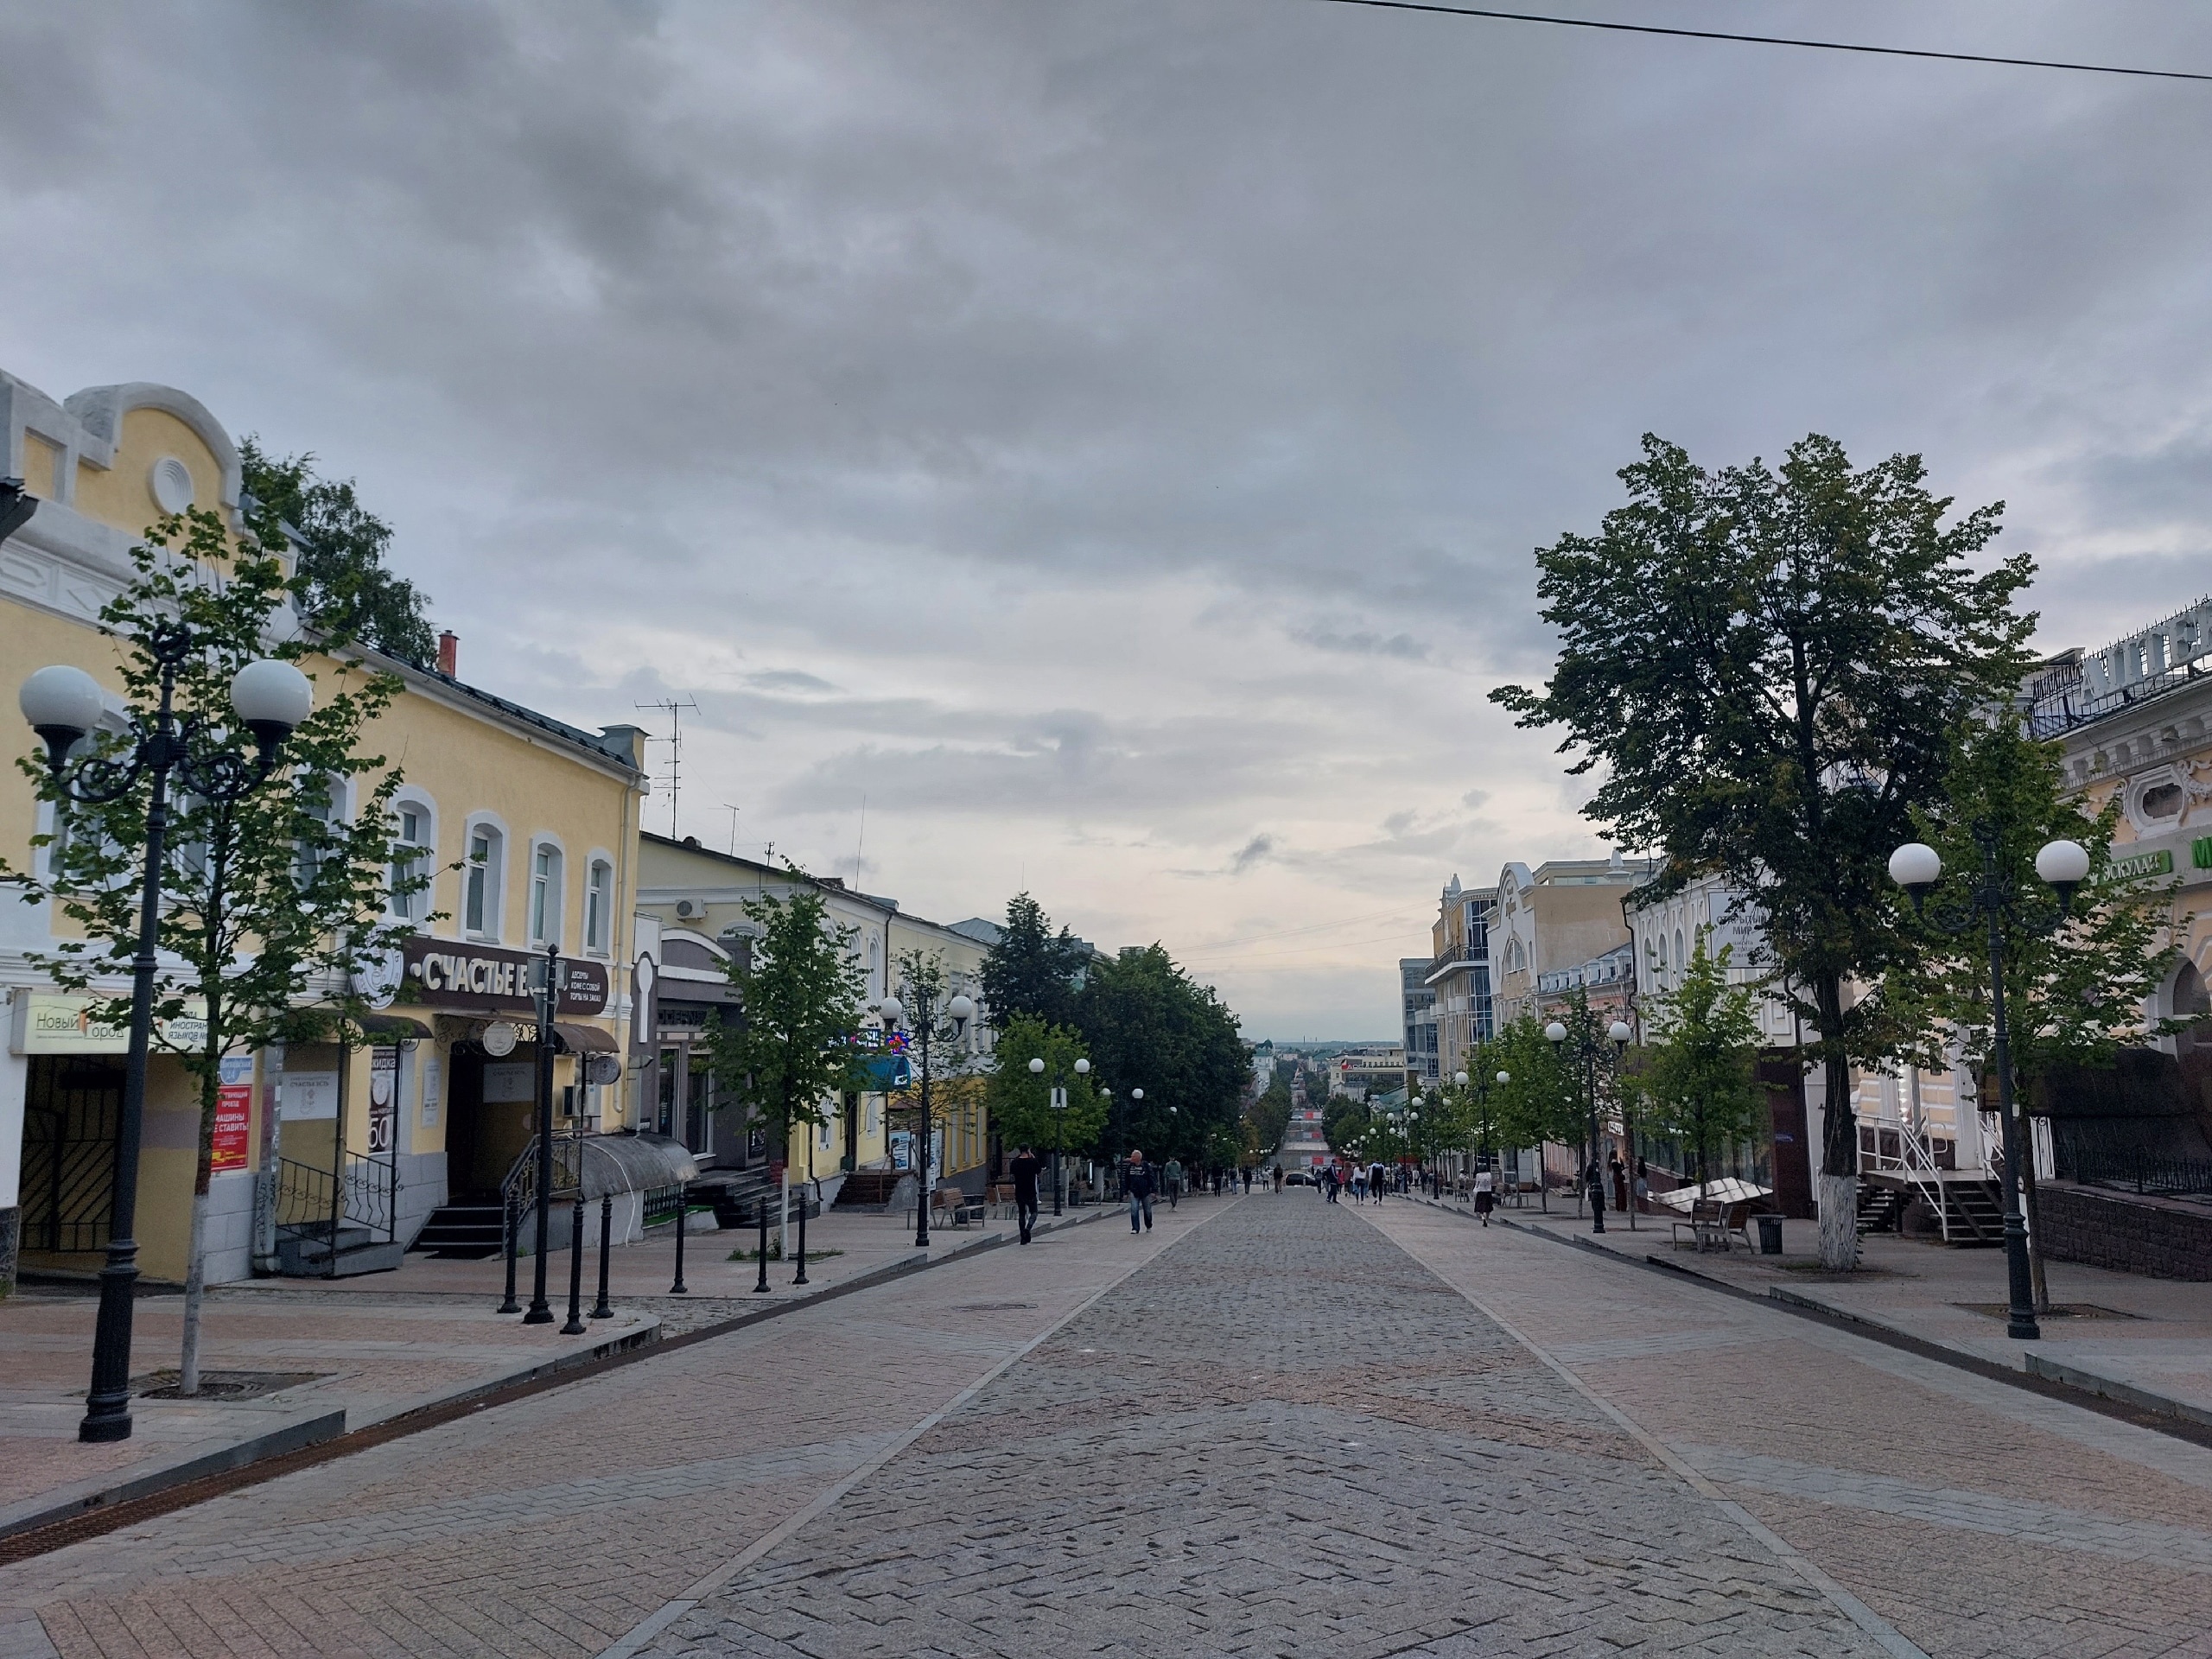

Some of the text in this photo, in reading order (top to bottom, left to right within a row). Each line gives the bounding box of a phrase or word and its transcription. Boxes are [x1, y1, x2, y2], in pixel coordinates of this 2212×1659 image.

[1732, 925, 1752, 935] МИР
[422, 953, 515, 996] СЧАСТЬЕ
[36, 1012, 79, 1029] Новый
[169, 1021, 207, 1030] ИНОСТРАН
[372, 1058, 396, 1070] кидка
